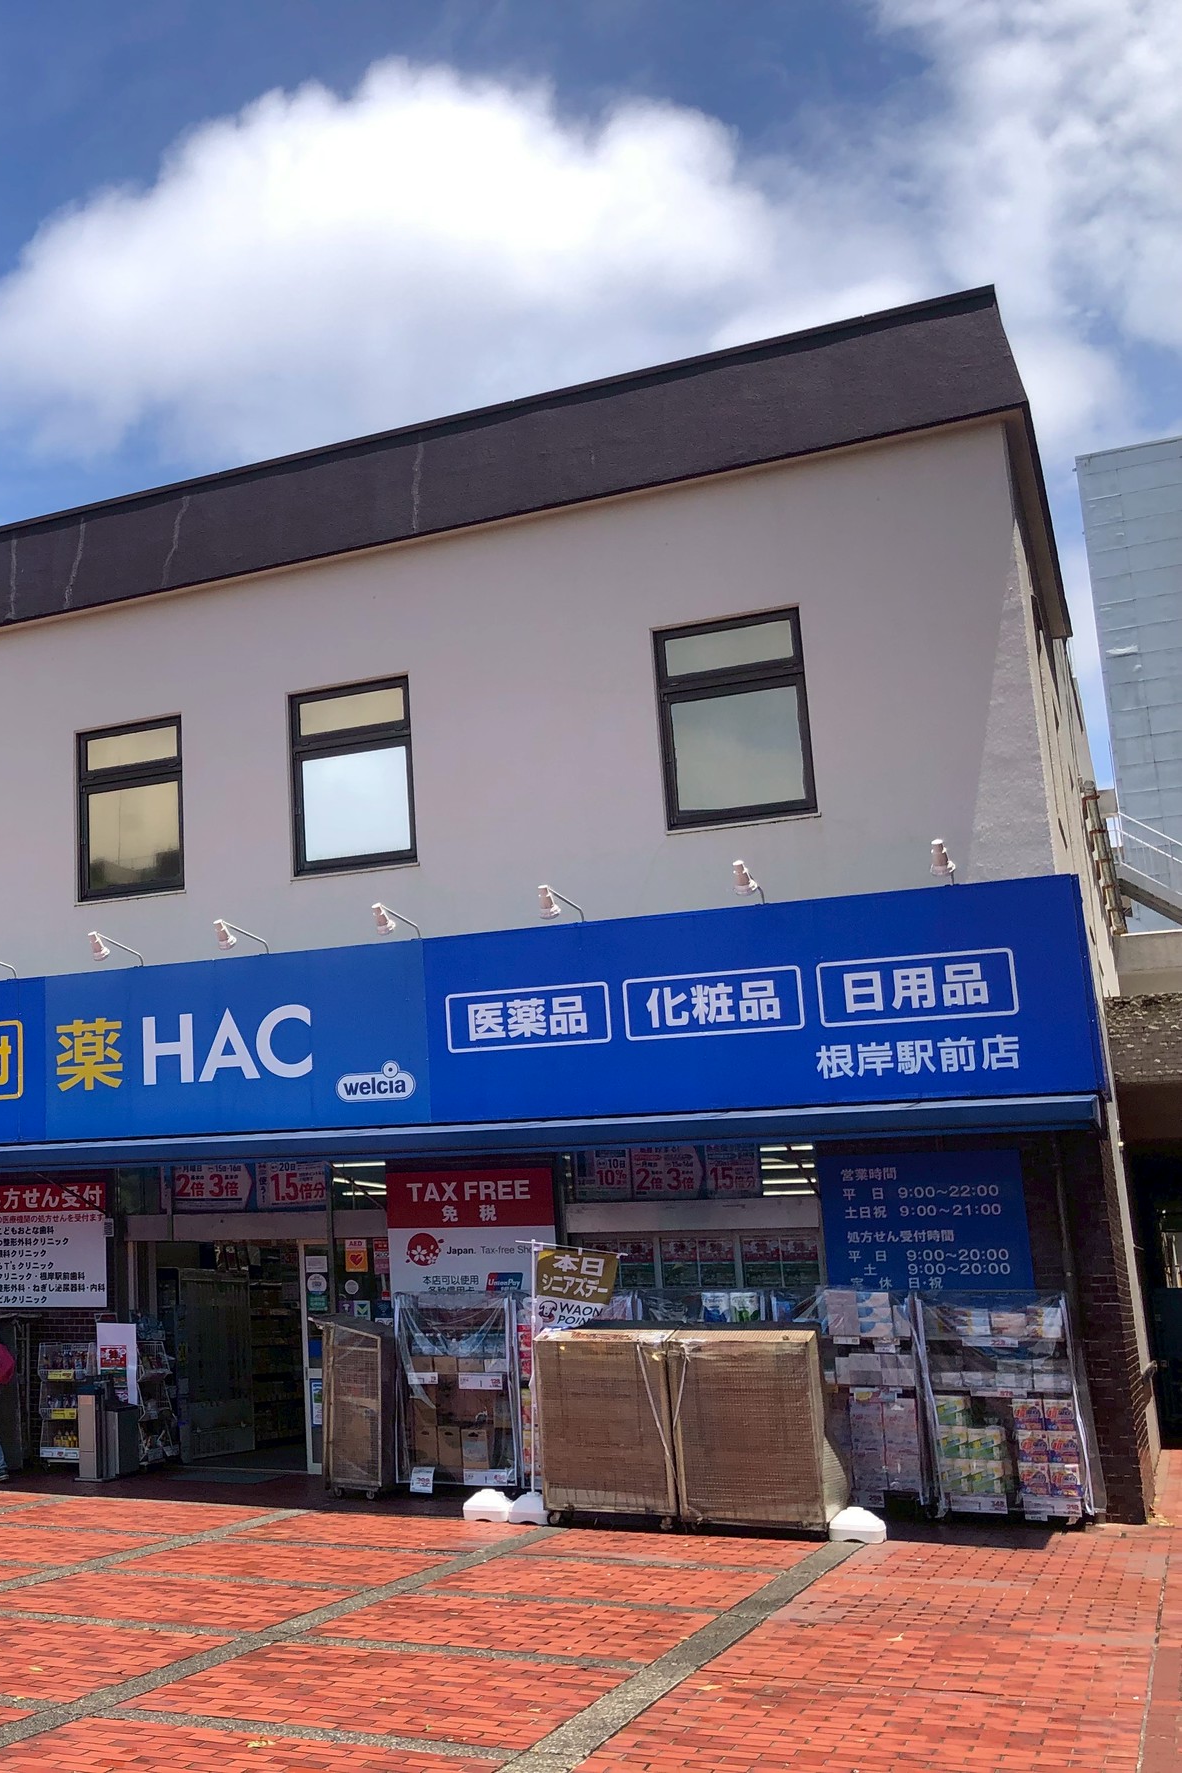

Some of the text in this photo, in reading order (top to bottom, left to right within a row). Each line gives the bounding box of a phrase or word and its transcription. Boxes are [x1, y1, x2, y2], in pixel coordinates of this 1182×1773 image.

[842, 962, 990, 1013] 日用品
[646, 979, 782, 1029] 化粧品
[467, 994, 589, 1041] 医薬品
[55, 1004, 314, 1093] 薬 HAC
[816, 1035, 1021, 1081] 根岸駅前店
[343, 1071, 407, 1097] welcia
[840, 1166, 897, 1182] 営業時間
[406, 1179, 531, 1202] TAX FREE
[844, 1205, 887, 1219] 土日祝
[847, 1229, 955, 1244] 処方せん受付時間
[480, 1245, 515, 1254] Tax-free
[517, 1245, 533, 1254] Sho
[552, 1254, 605, 1277] 本日
[863, 1263, 878, 1276] 土
[423, 1275, 479, 1285] 本店可以使用
[488, 1278, 521, 1288] UnionPay
[541, 1273, 608, 1298] シニアズデー
[559, 1302, 604, 1317] WAON
[557, 1314, 592, 1325] POIN
